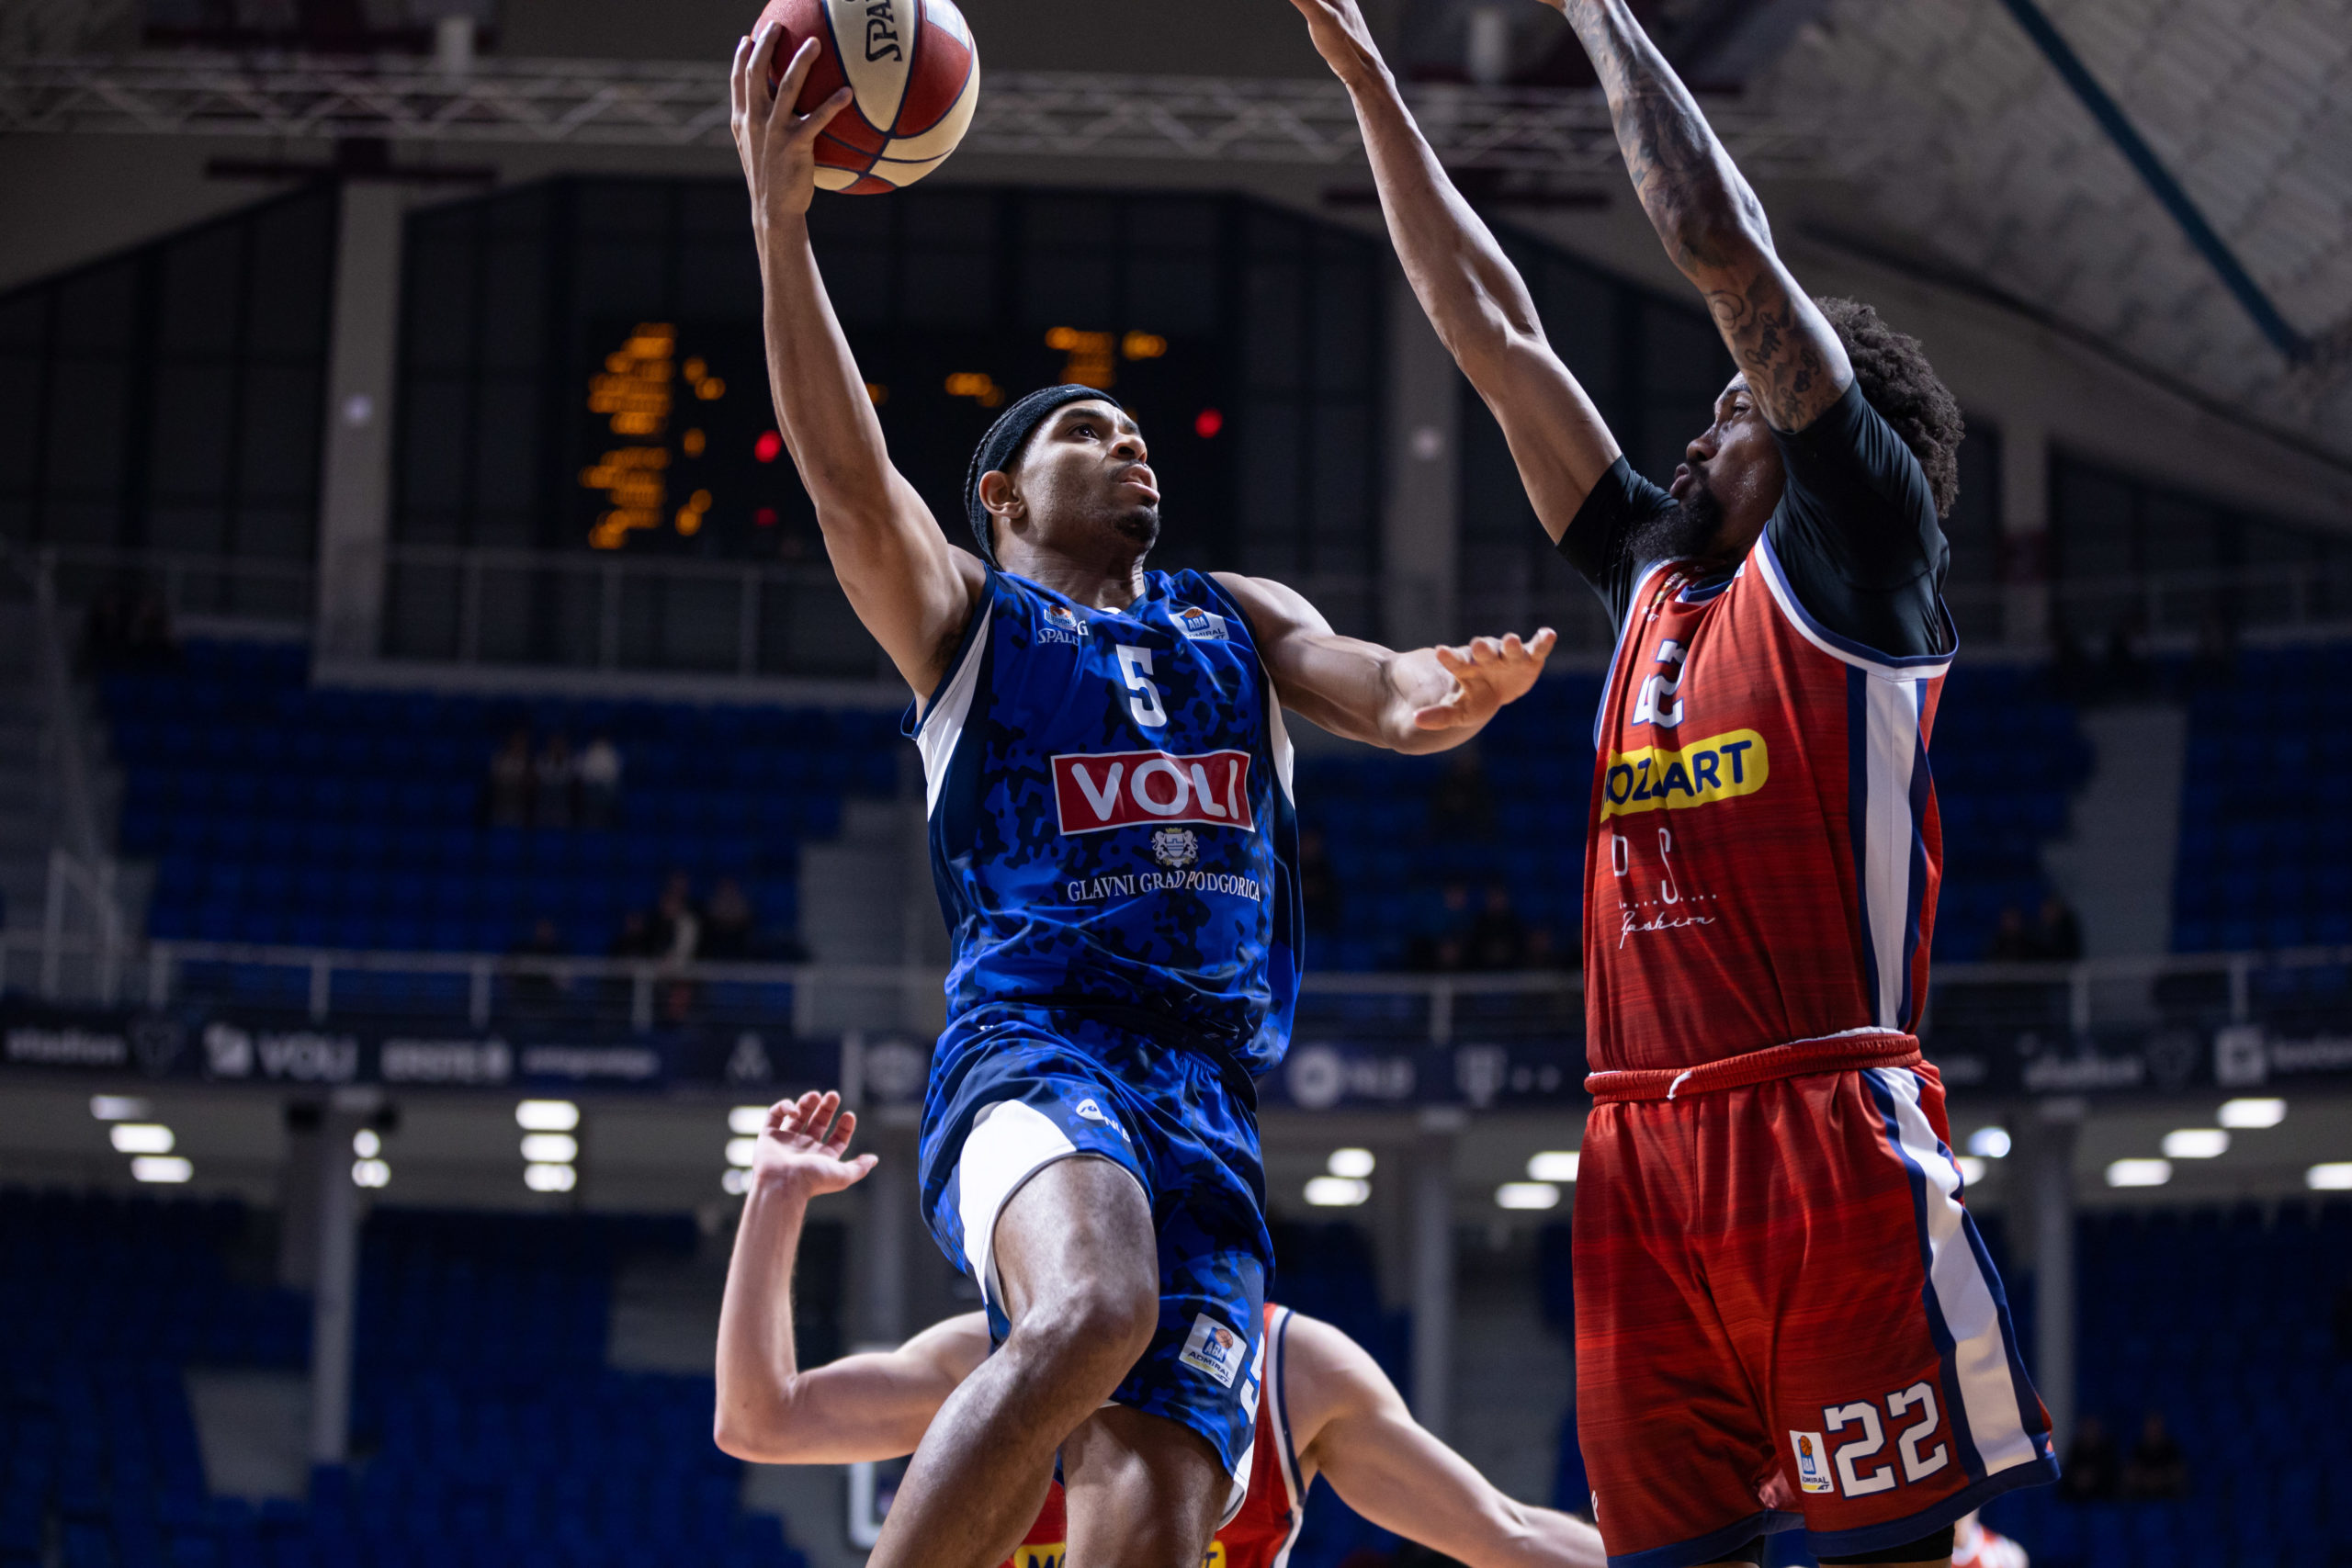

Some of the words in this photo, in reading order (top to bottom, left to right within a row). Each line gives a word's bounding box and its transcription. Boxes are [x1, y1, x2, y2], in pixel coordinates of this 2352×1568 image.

[865, 0, 902, 62] SPA
[1187, 615, 1208, 631] ABA
[1115, 644, 1168, 728] 5
[1071, 758, 1239, 822] VOLI
[1067, 874, 1135, 903] GLAVNI
[1140, 870, 1183, 894] GRAD
[1184, 870, 1261, 904] PODGORICA
[1188, 1350, 1230, 1378] ADMIRAL
[1204, 1341, 1226, 1361] ABA
[1822, 1380, 1950, 1500] 22
